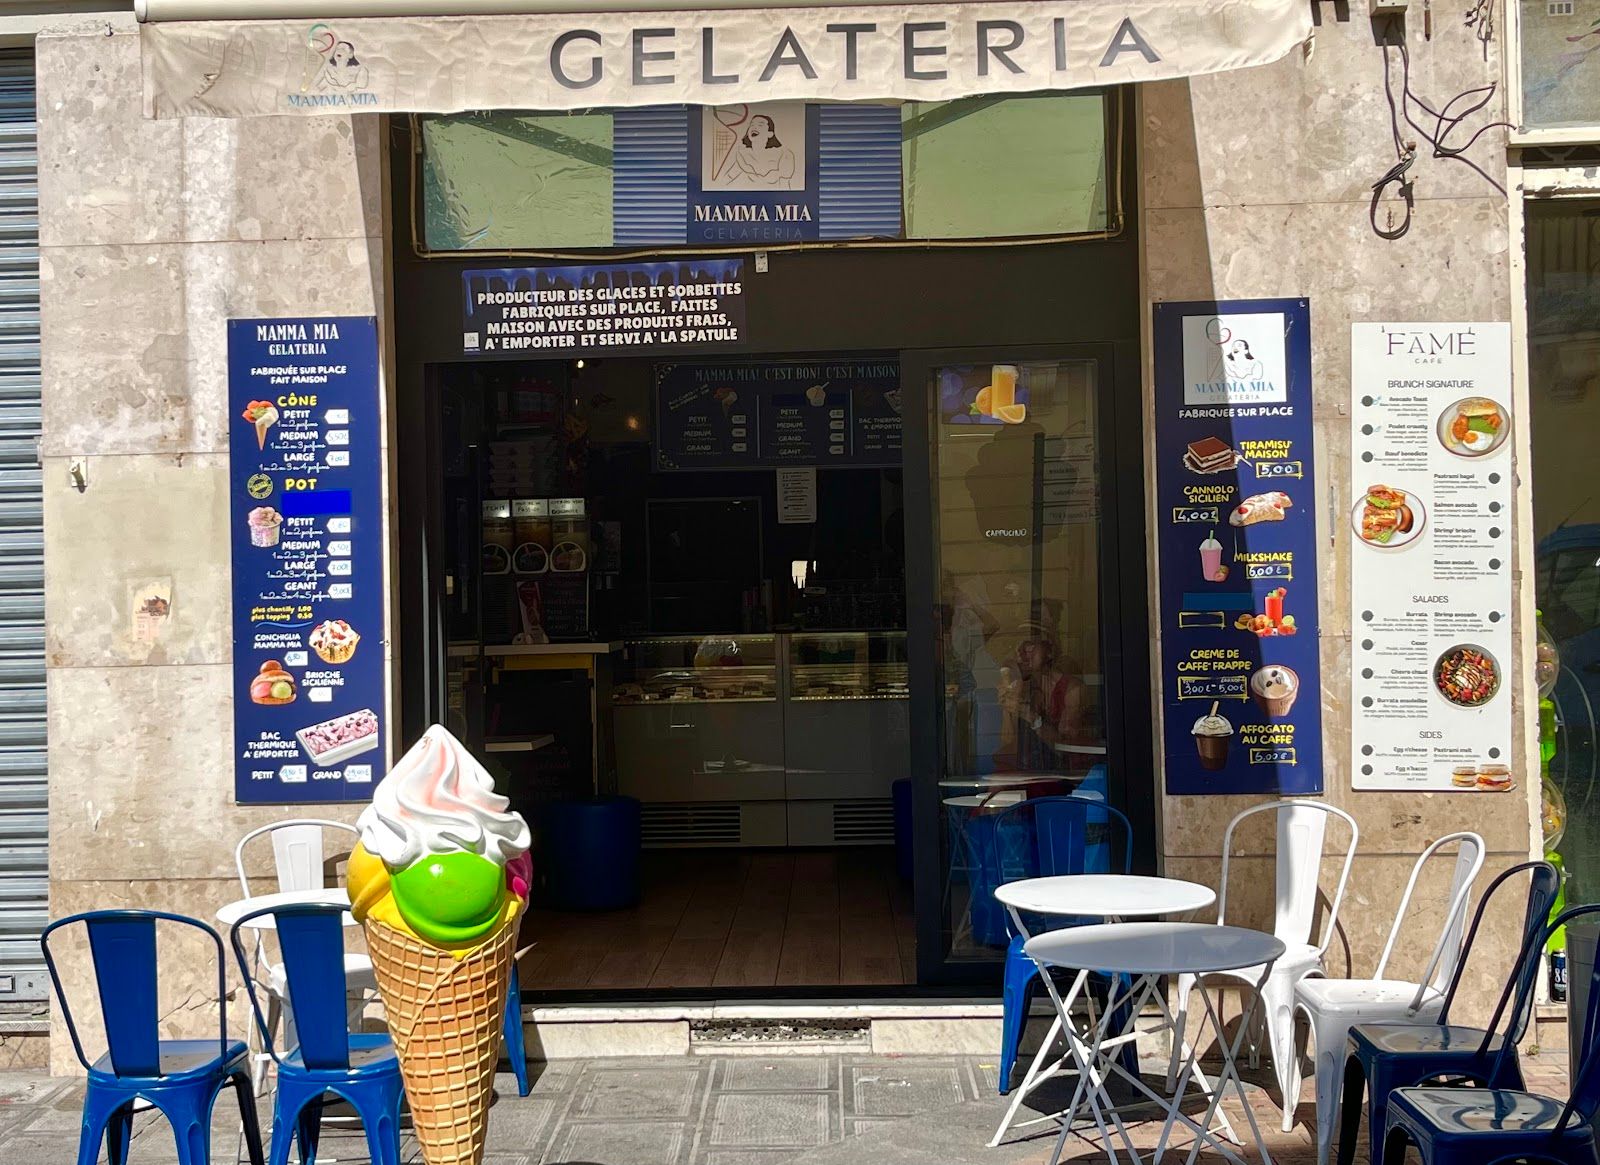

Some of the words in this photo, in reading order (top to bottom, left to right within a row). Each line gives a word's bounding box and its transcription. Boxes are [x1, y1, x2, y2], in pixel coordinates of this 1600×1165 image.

[549, 17, 1162, 89] GELATERIA
[288, 94, 346, 107] MAMMA
[350, 93, 378, 104] MIA
[694, 205, 770, 222] MAMMA
[775, 204, 812, 222] MIA
[704, 228, 803, 240] GELATERIA
[478, 290, 566, 304] PRODUCTEUR
[568, 289, 594, 302] DES
[596, 286, 646, 300] GLACES
[650, 286, 665, 298] ET
[668, 283, 742, 298] SORBETTES
[502, 305, 587, 319] FABRIQUEES
[590, 304, 616, 316] SUR
[620, 302, 666, 314] PLACE,
[671, 299, 718, 312] FAITES
[487, 321, 545, 334] MAISON
[548, 320, 584, 332] AVEC
[586, 318, 612, 331] DES
[615, 315, 683, 330] PRODUITS
[686, 314, 732, 326] FRAIS,
[257, 324, 307, 341] MAMMA
[314, 324, 339, 340] MIA
[484, 338, 498, 350] A'
[502, 335, 576, 349] EMPORTER
[581, 334, 596, 346] ET
[600, 332, 640, 346] SERVI
[643, 332, 657, 344] A'
[660, 330, 677, 343] LA
[680, 328, 738, 342] SPATULE
[269, 343, 327, 356] GELATERIA
[300, 366, 317, 374] SUR
[318, 366, 347, 374] PLACE
[695, 368, 734, 382] MAMMA
[270, 376, 290, 384] FAIT
[292, 376, 328, 384] MAISON
[1388, 380, 1424, 388] BRUNCH
[1426, 380, 1474, 388] SIGNATURE
[1194, 382, 1246, 394] MAMMA
[1250, 381, 1274, 392] MIA
[277, 392, 318, 408] CÔNE
[284, 410, 310, 419] PETIT
[1178, 408, 1235, 419] FABRIQUEE
[1237, 408, 1256, 417] SUR
[1259, 406, 1293, 416] PLACE
[280, 431, 318, 440] MEDIUM
[284, 453, 315, 462] LARGE
[1245, 450, 1288, 459] MAISON
[285, 479, 317, 490] POT
[1183, 486, 1234, 495] CANNOLO
[1188, 494, 1229, 503] SICILIEN
[288, 518, 315, 526] PETIT
[282, 541, 320, 550] MEDIUM
[1234, 552, 1293, 562] MILKSHAKE
[284, 561, 315, 570] LARGE
[284, 582, 317, 591] GEANT
[1412, 596, 1449, 604] SALADES
[1190, 649, 1225, 659] CREME
[1227, 649, 1239, 659] DE
[302, 678, 344, 686] SICILIENNE
[1239, 724, 1295, 734] AFFOGATO
[261, 732, 281, 740] BAC
[1242, 736, 1257, 744] AU
[248, 741, 296, 749] THERMIQUE
[253, 750, 299, 758] EMPORTER
[252, 770, 274, 779] PETIT
[312, 771, 341, 779] GRAND
